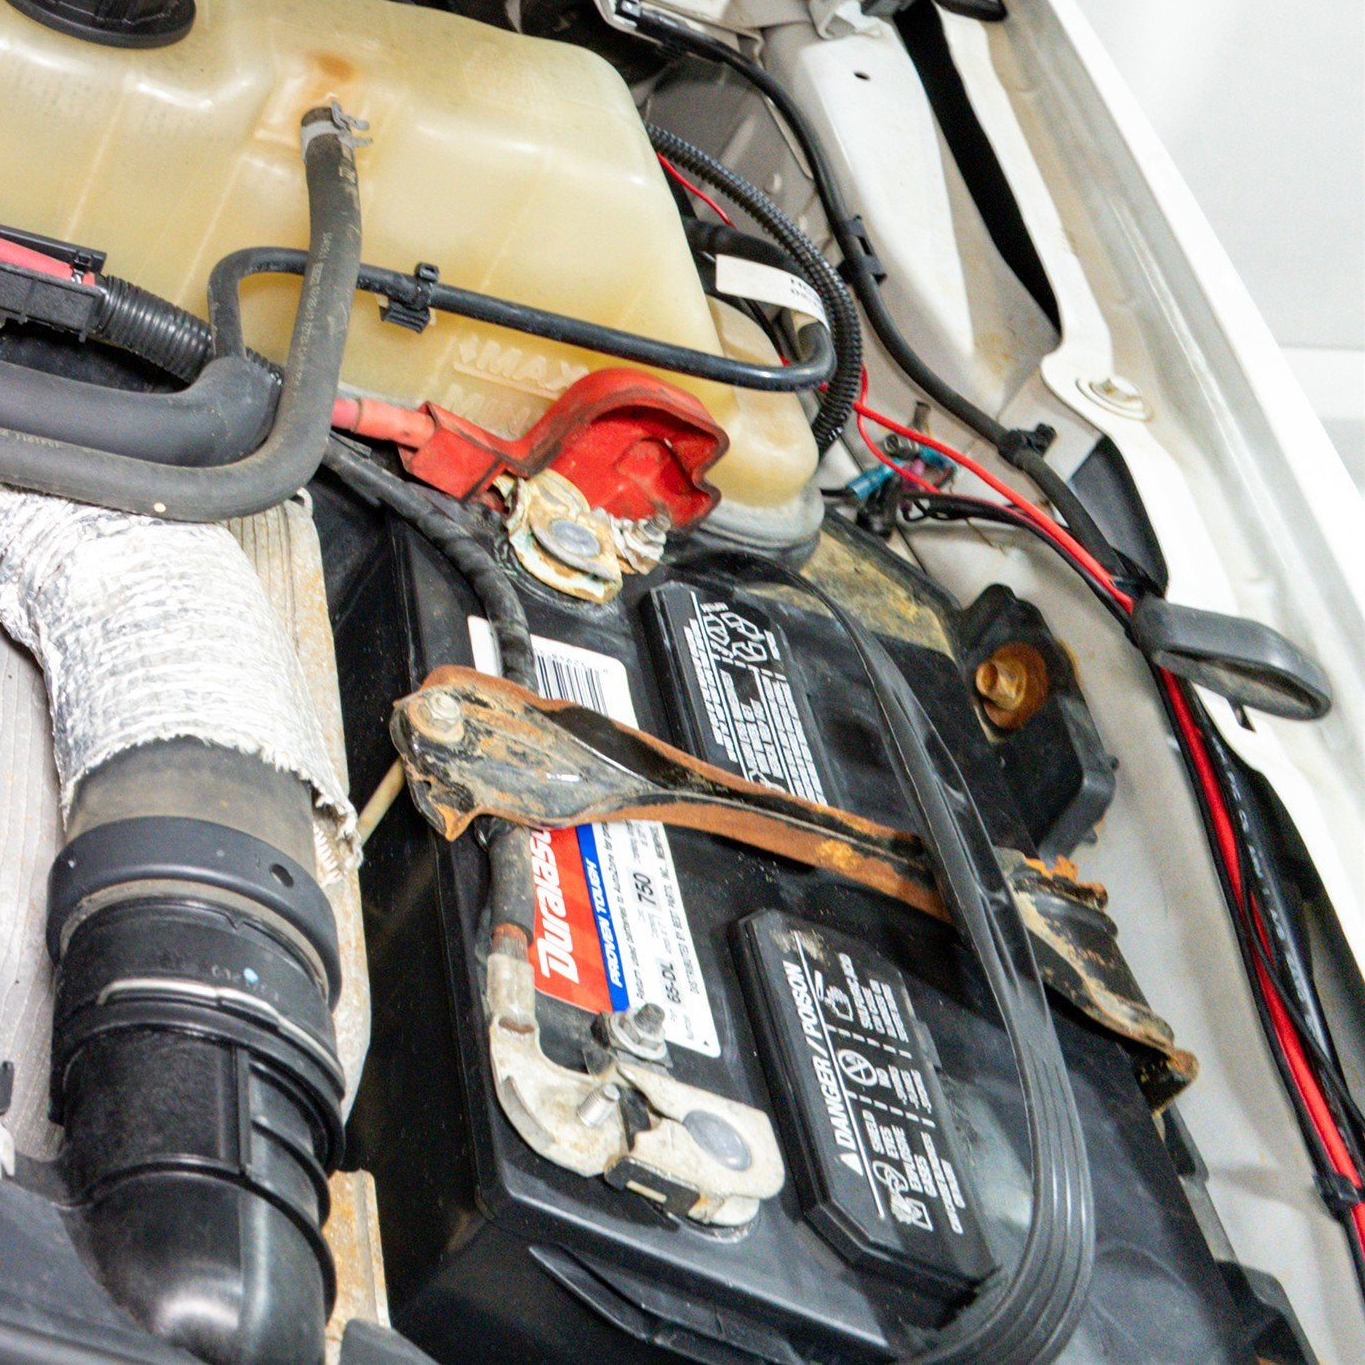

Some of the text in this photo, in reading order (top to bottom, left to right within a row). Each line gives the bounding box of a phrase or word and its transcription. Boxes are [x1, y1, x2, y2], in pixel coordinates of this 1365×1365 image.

[476, 338, 589, 392] MAX
[633, 871, 656, 905] 750
[586, 858, 622, 988] PROVEN TOUGH
[660, 961, 681, 1004] 65-DL
[782, 959, 822, 1039] POISON
[838, 952, 873, 1030] SULFURIC ACID
[812, 1055, 856, 1151] DANGER
[862, 1109, 885, 1155] SHIELD
[878, 1124, 900, 1160] EYES
[891, 1124, 924, 1193] EXPLOSIVE
[913, 1153, 938, 1198] GASES
